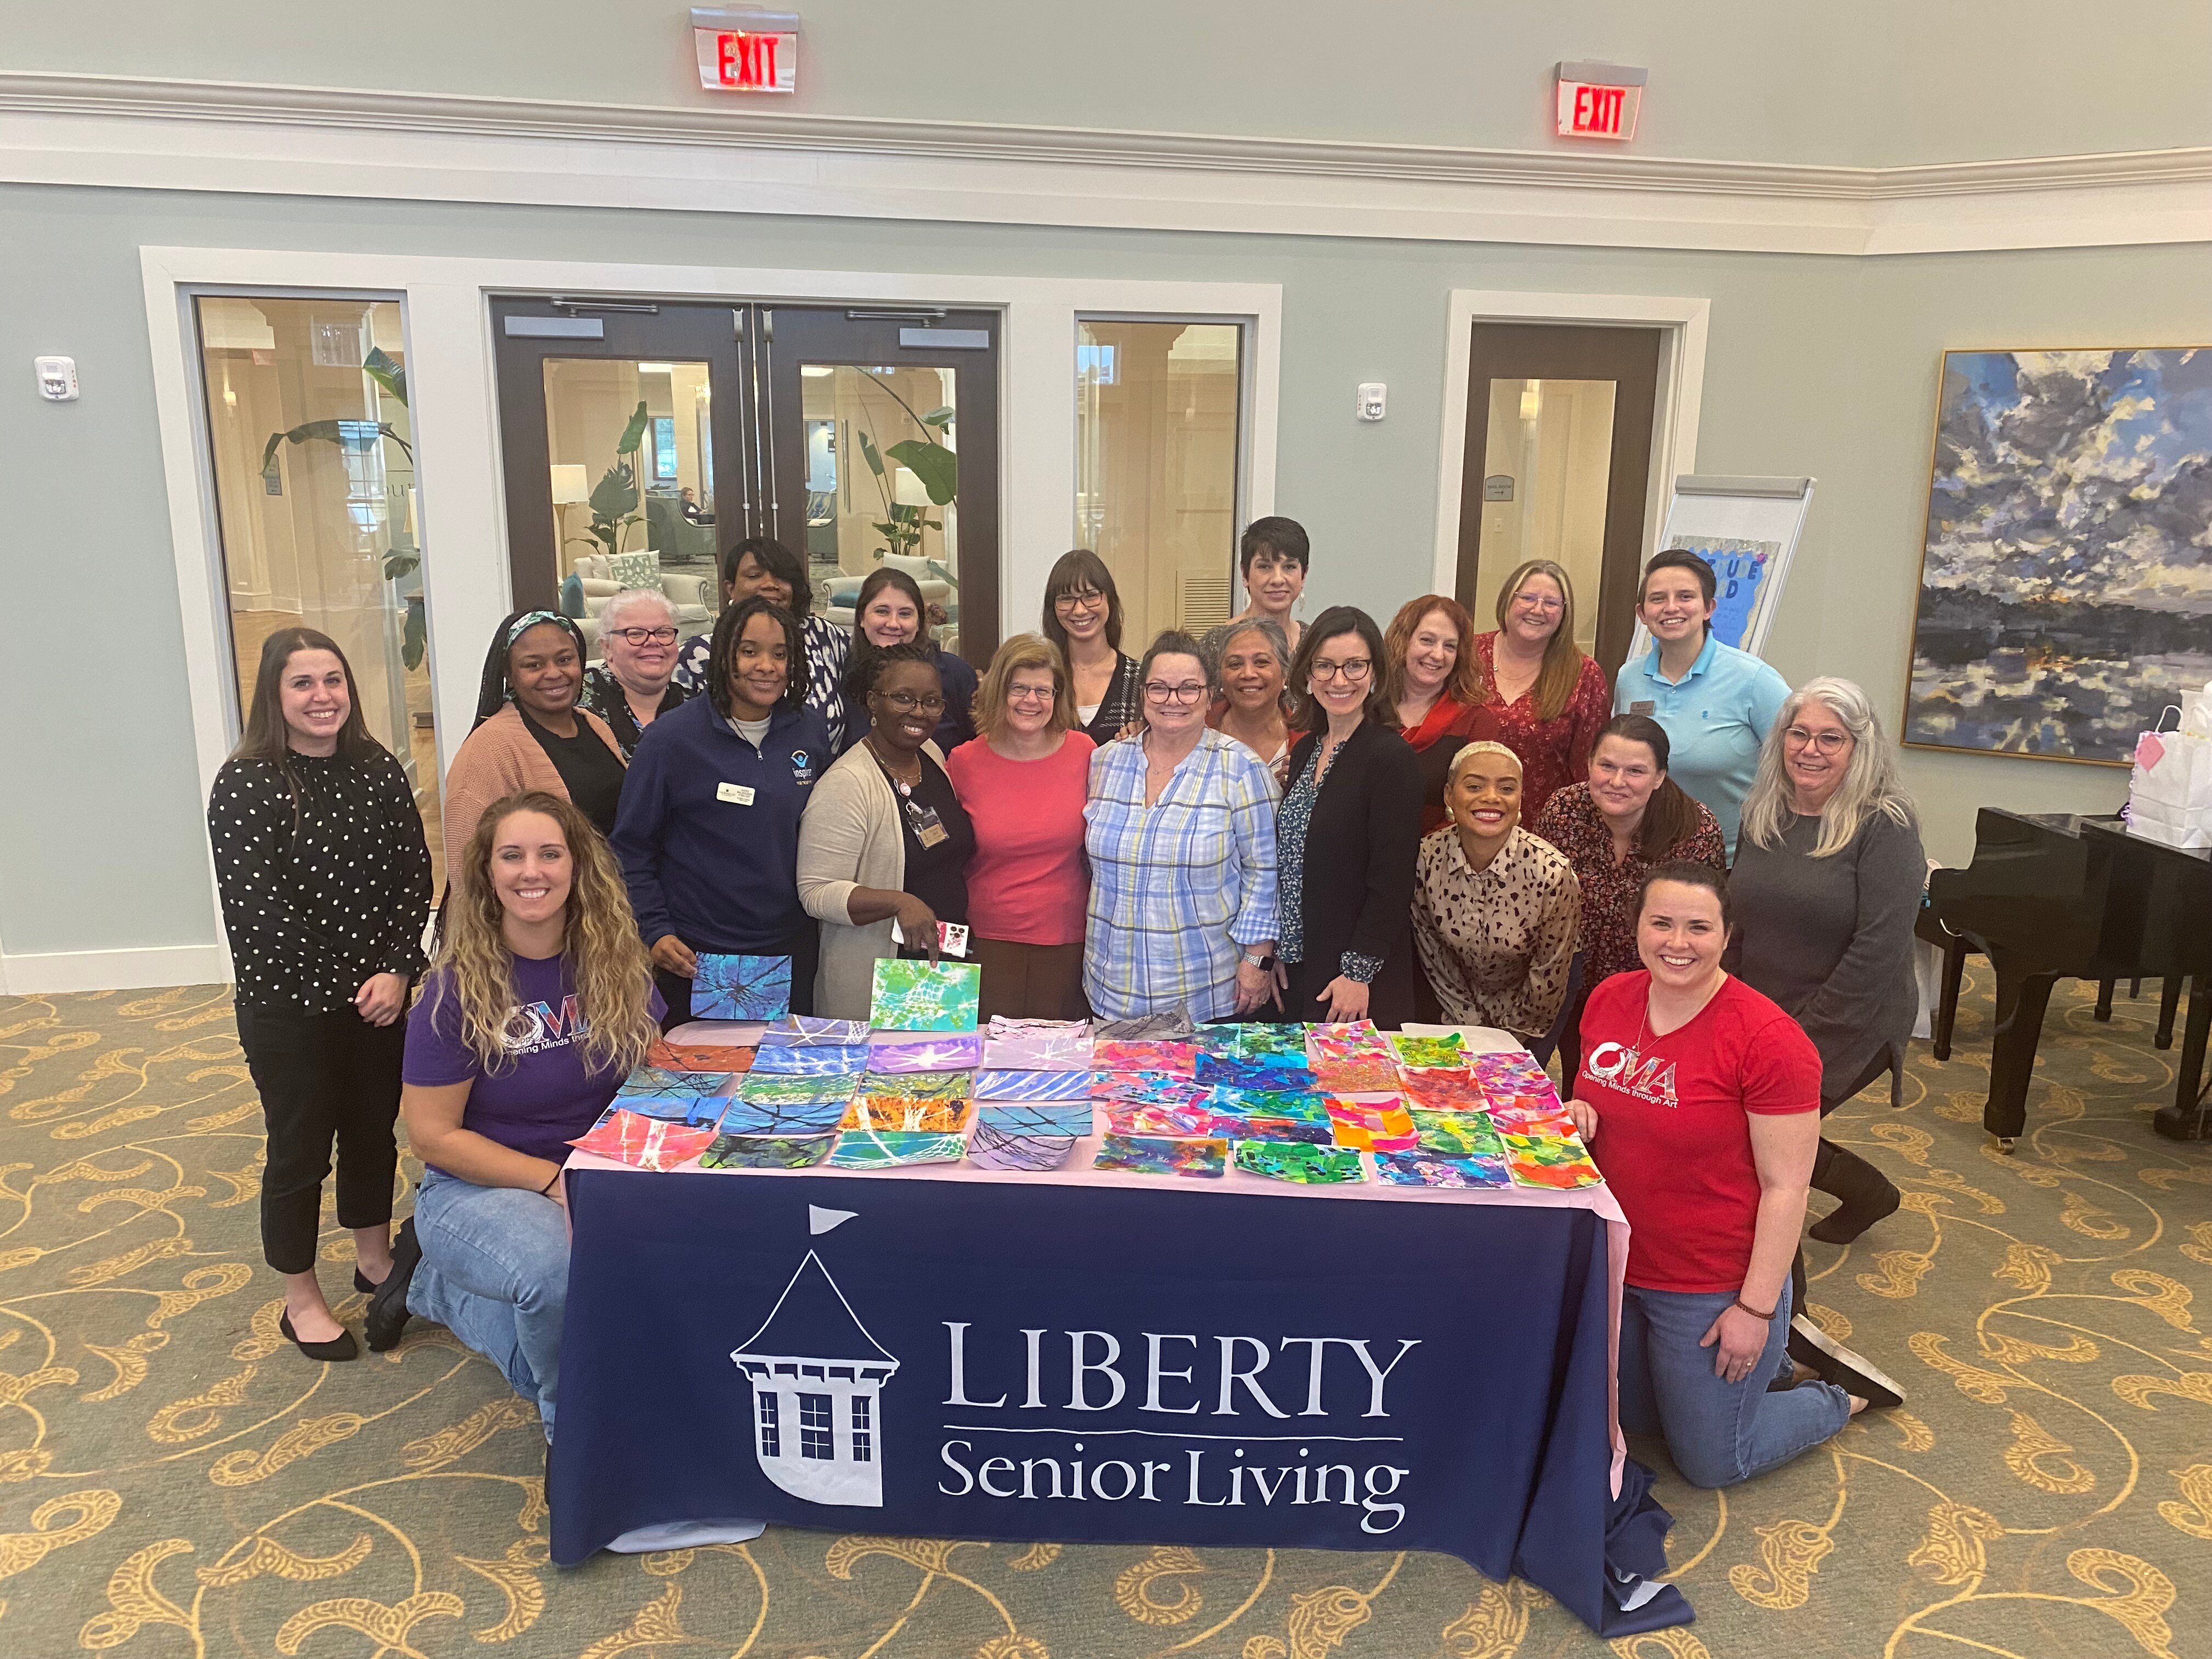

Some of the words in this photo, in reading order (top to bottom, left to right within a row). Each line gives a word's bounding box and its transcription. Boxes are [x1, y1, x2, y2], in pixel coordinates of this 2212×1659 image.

[717, 34, 780, 87] EXIT
[1572, 86, 1627, 133] EXIT
[509, 1045, 539, 1055] ening
[541, 1038, 569, 1050] Minds
[1589, 1041, 1679, 1102] OMA
[1582, 1070, 1607, 1087] Opening
[1608, 1080, 1630, 1094] Minds
[1632, 1089, 1662, 1104] through
[1662, 1098, 1678, 1108] Art
[941, 1321, 1422, 1419] LIBERTY
[938, 1440, 1171, 1502] Senior
[1183, 1448, 1409, 1534] Living
